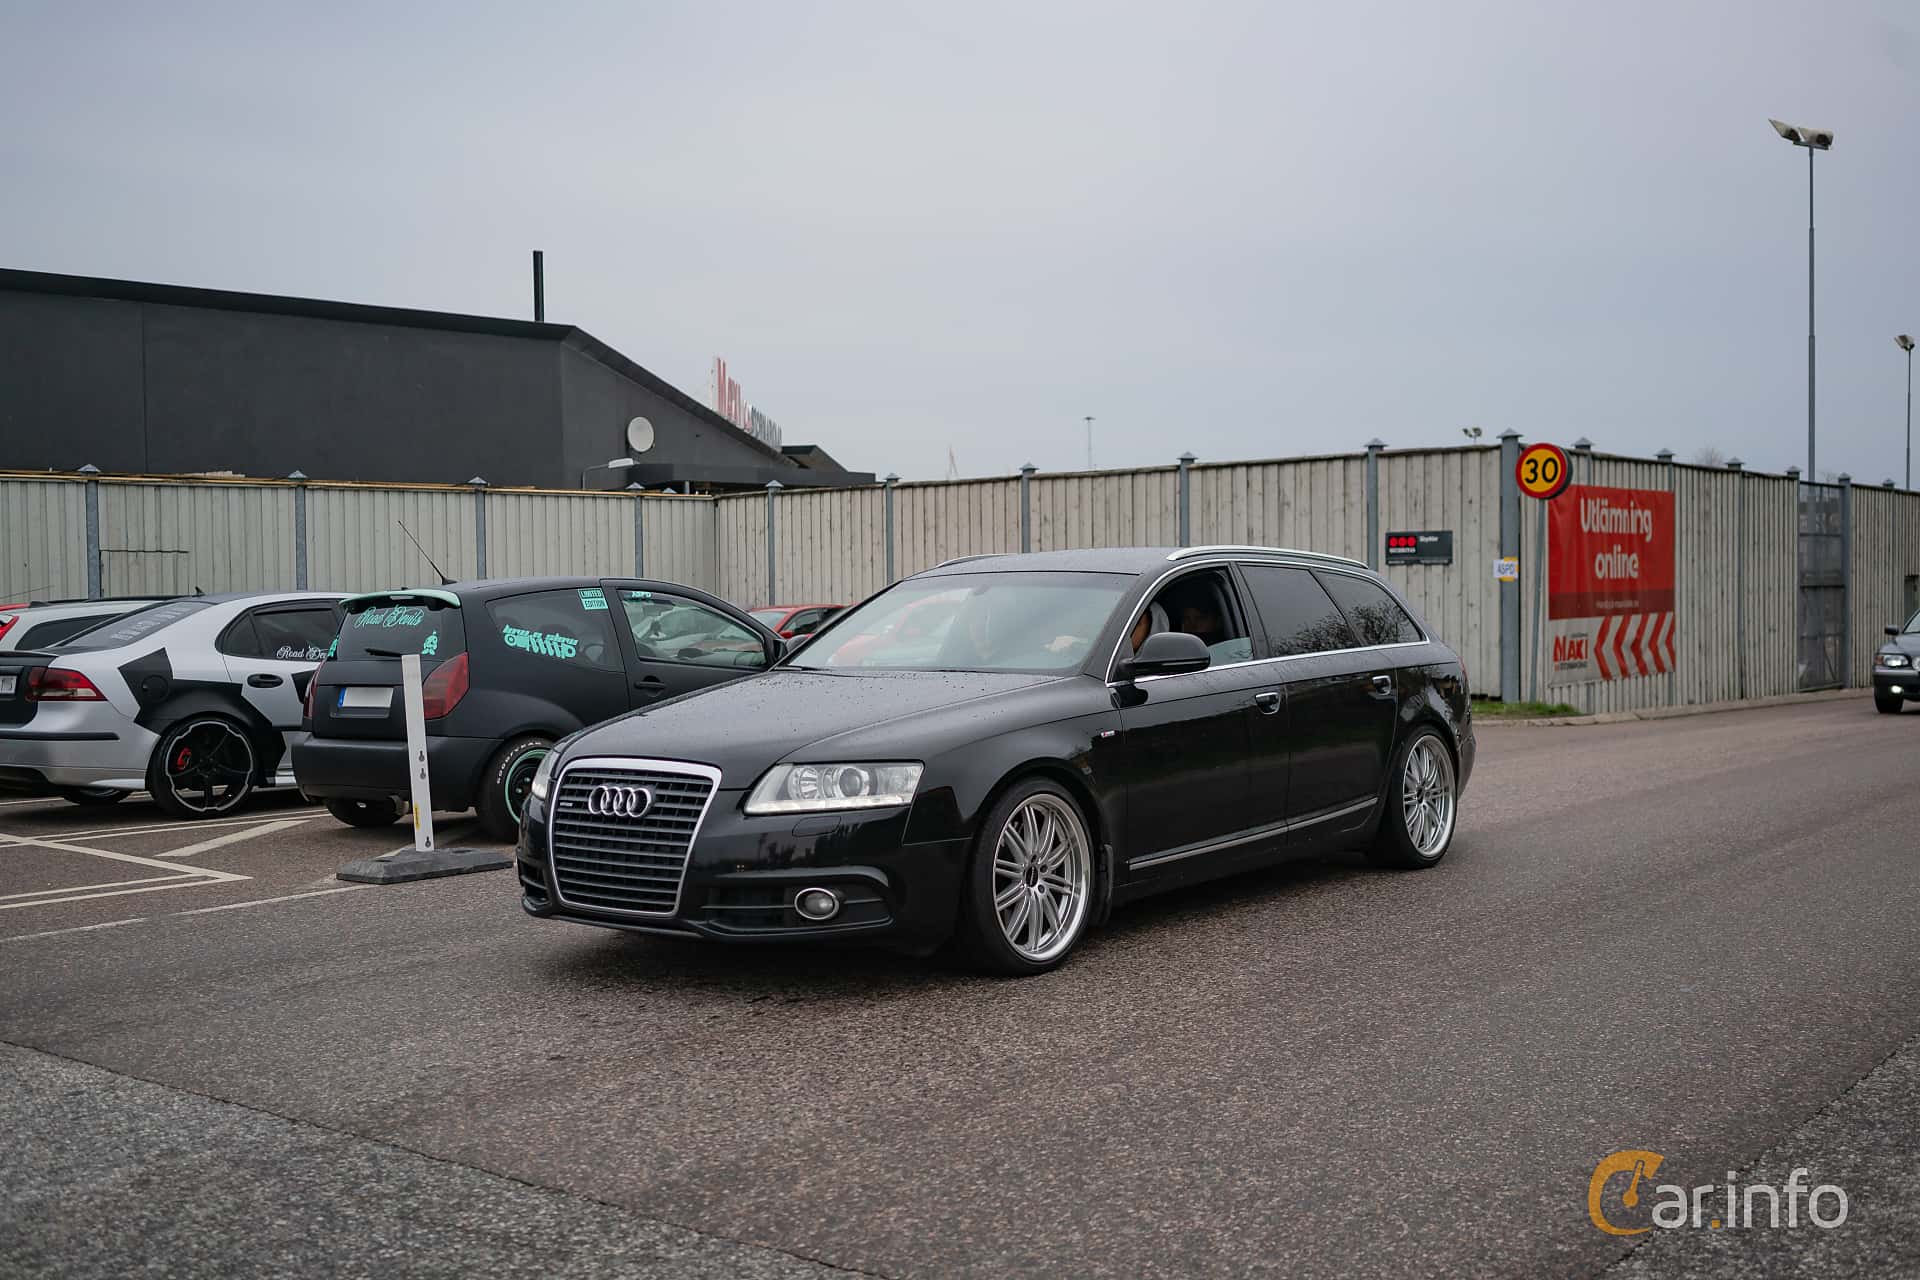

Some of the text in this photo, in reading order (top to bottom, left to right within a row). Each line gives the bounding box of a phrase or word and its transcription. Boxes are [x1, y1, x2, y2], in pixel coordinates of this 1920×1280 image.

[1525, 457, 1558, 484] 30
[1580, 497, 1652, 543] Utlämning
[1595, 544, 1639, 579] online
